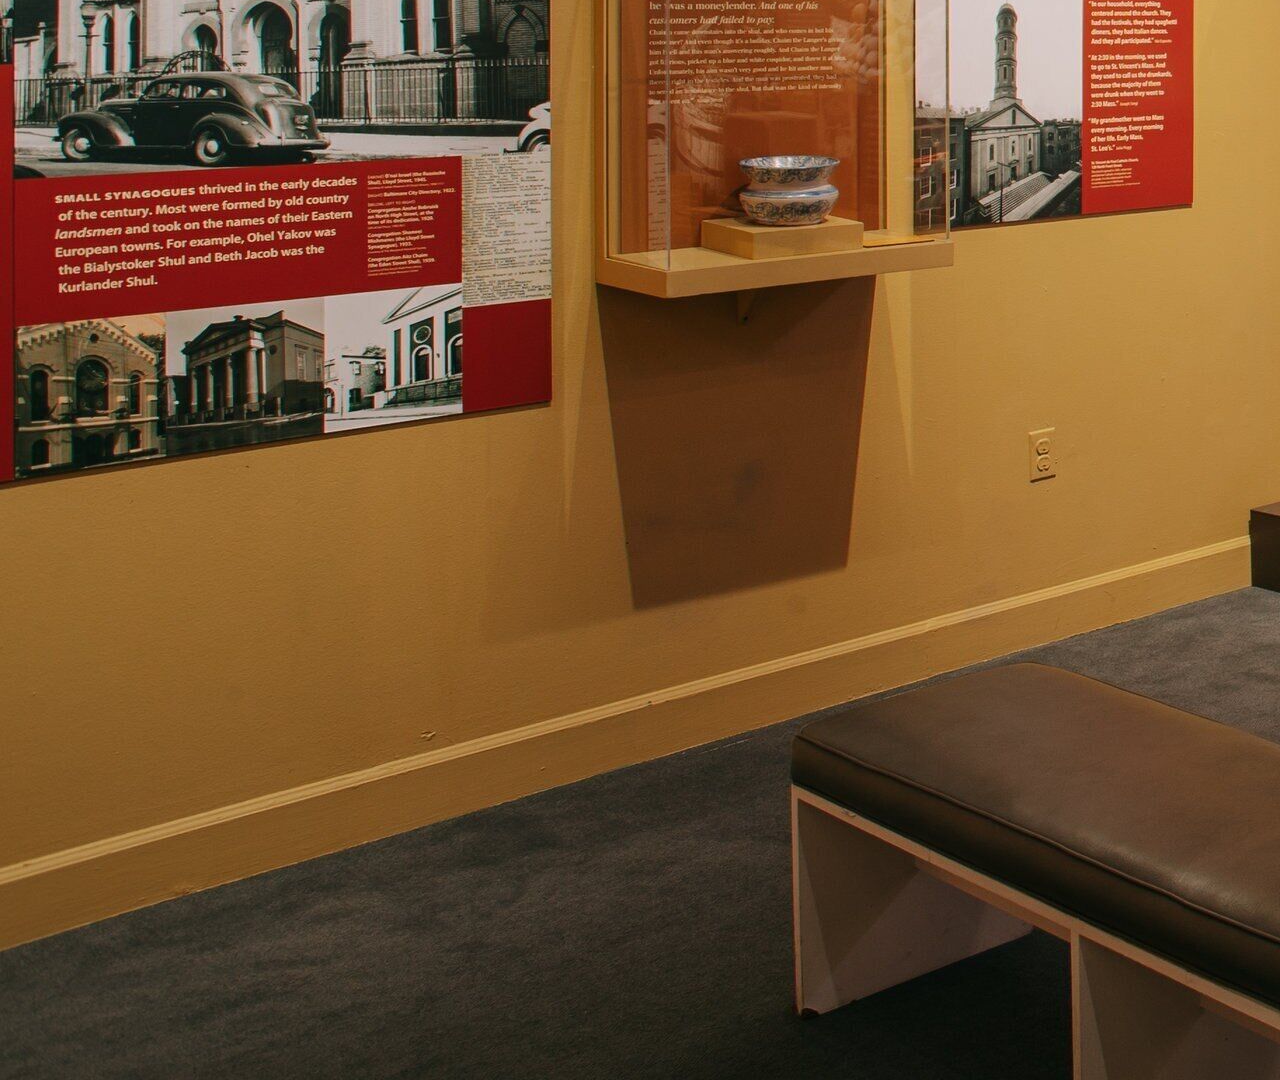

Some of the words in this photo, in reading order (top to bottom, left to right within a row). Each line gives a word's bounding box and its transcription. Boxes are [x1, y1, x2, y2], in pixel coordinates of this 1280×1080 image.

[55, 193, 101, 204] SMALL
[104, 187, 196, 201] SYNAGOGUES
[198, 182, 243, 195] thrived
[245, 182, 256, 192] in
[258, 180, 279, 191] the
[281, 178, 310, 191] early
[311, 176, 358, 188] decades
[58, 278, 124, 293] Kurlander
